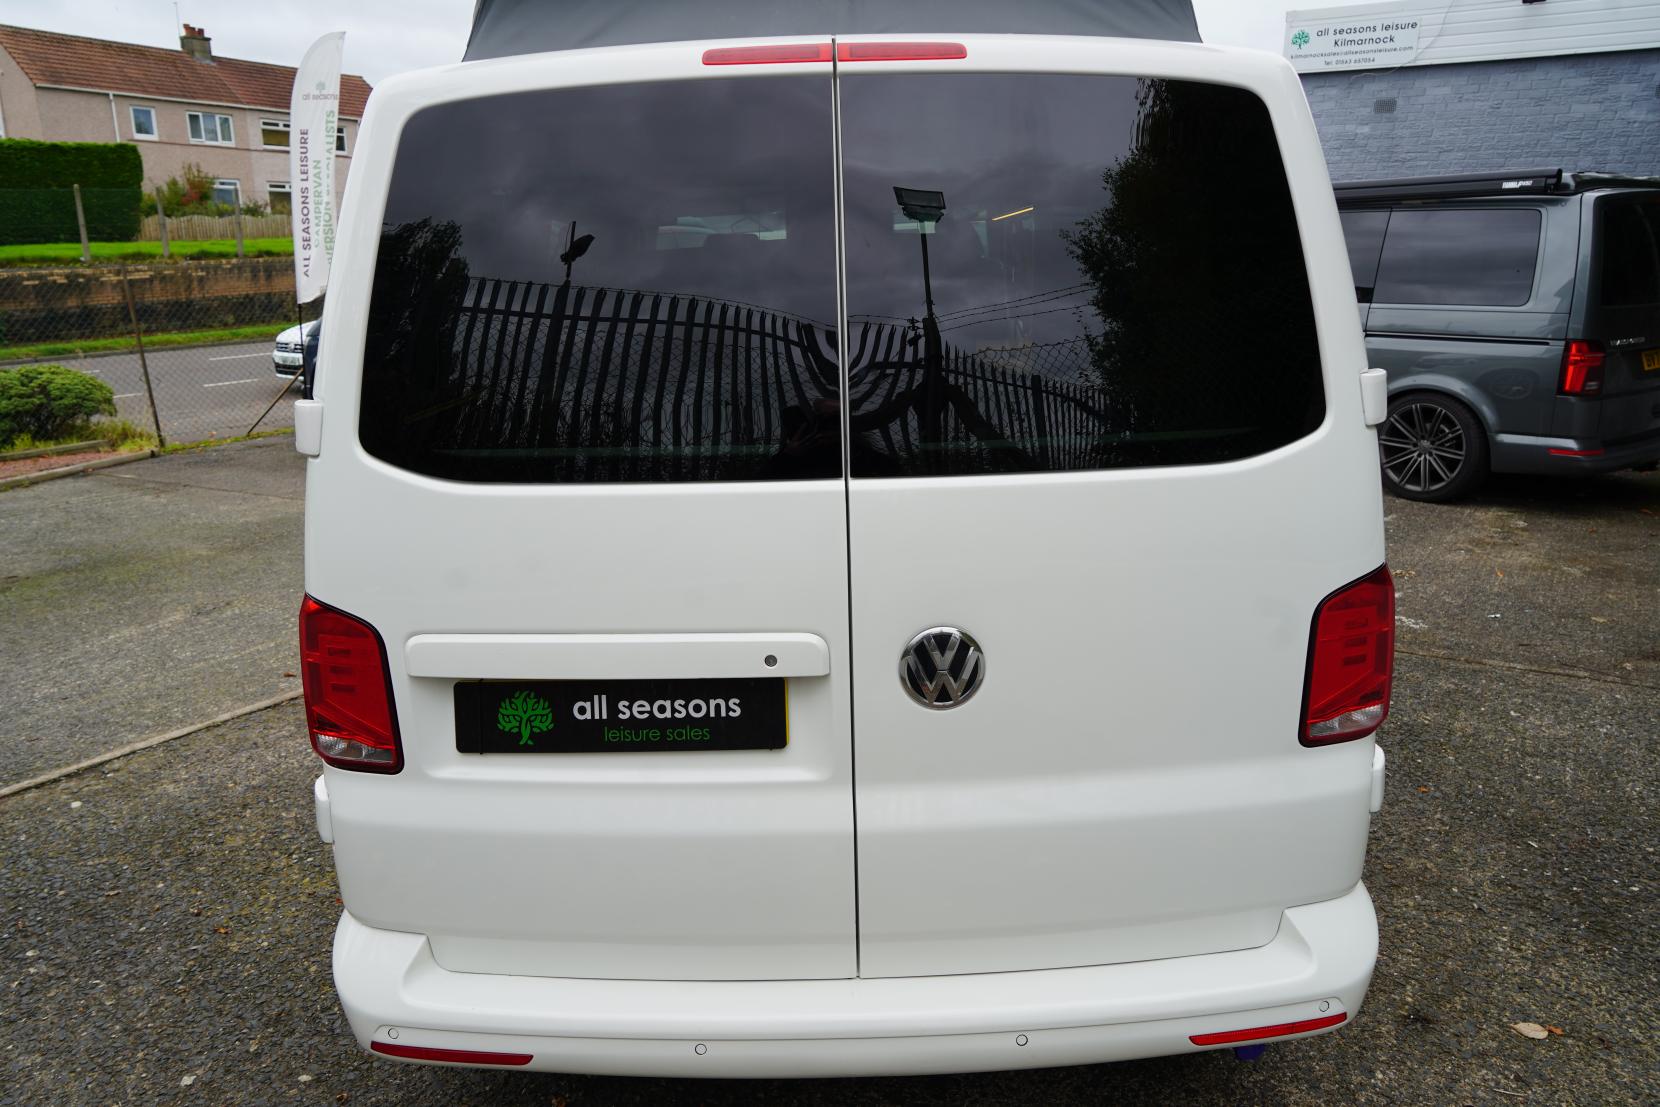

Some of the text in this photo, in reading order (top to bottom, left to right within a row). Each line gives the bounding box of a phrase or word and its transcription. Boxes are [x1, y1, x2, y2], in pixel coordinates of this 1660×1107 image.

[1316, 21, 1418, 37] all seasons leisure
[1333, 35, 1395, 48] Kilmarnock
[300, 129, 312, 278] ALL SEASONS LEISURE
[572, 694, 742, 721] all seasons
[604, 724, 711, 742] leisure sales
